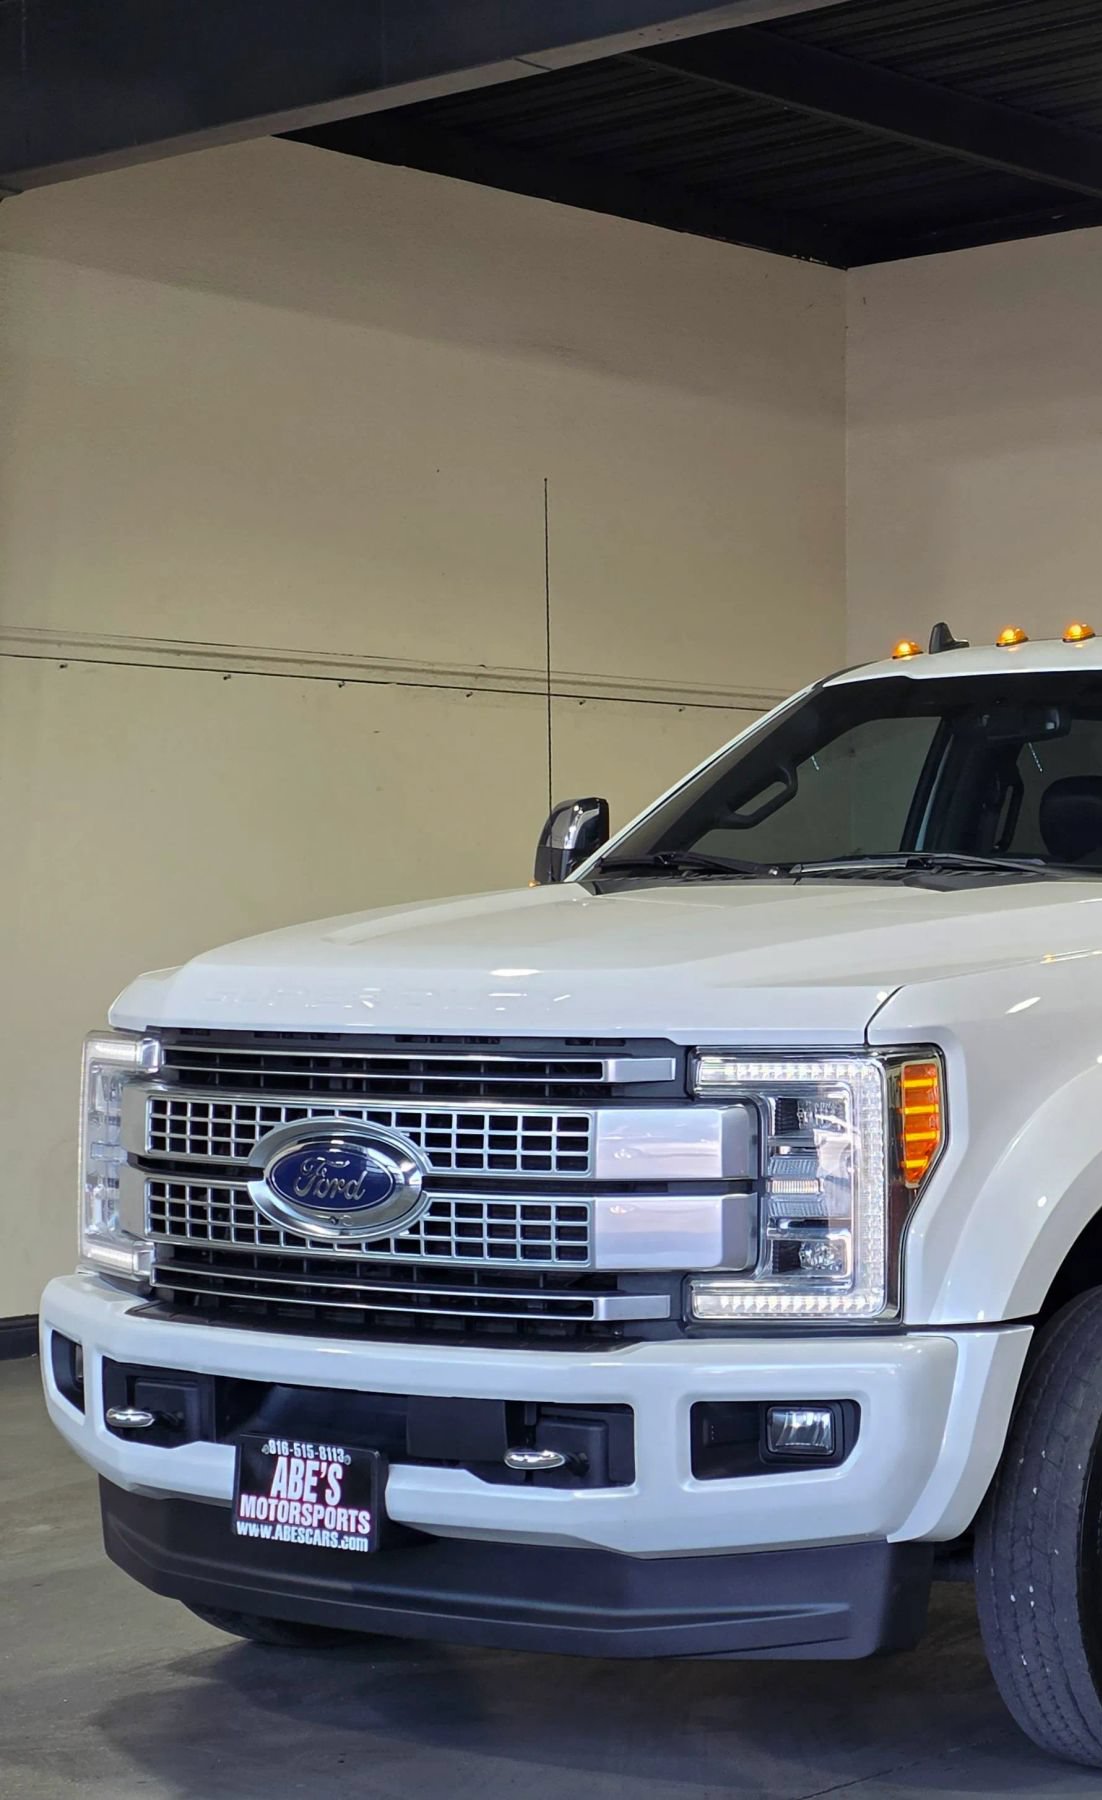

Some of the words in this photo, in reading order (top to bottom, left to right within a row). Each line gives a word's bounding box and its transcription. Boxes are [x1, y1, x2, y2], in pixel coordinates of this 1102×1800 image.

[293, 1156, 368, 1201] Ford
[270, 1456, 343, 1506] ABE'S
[239, 1494, 371, 1535] MOTORSPORTS
